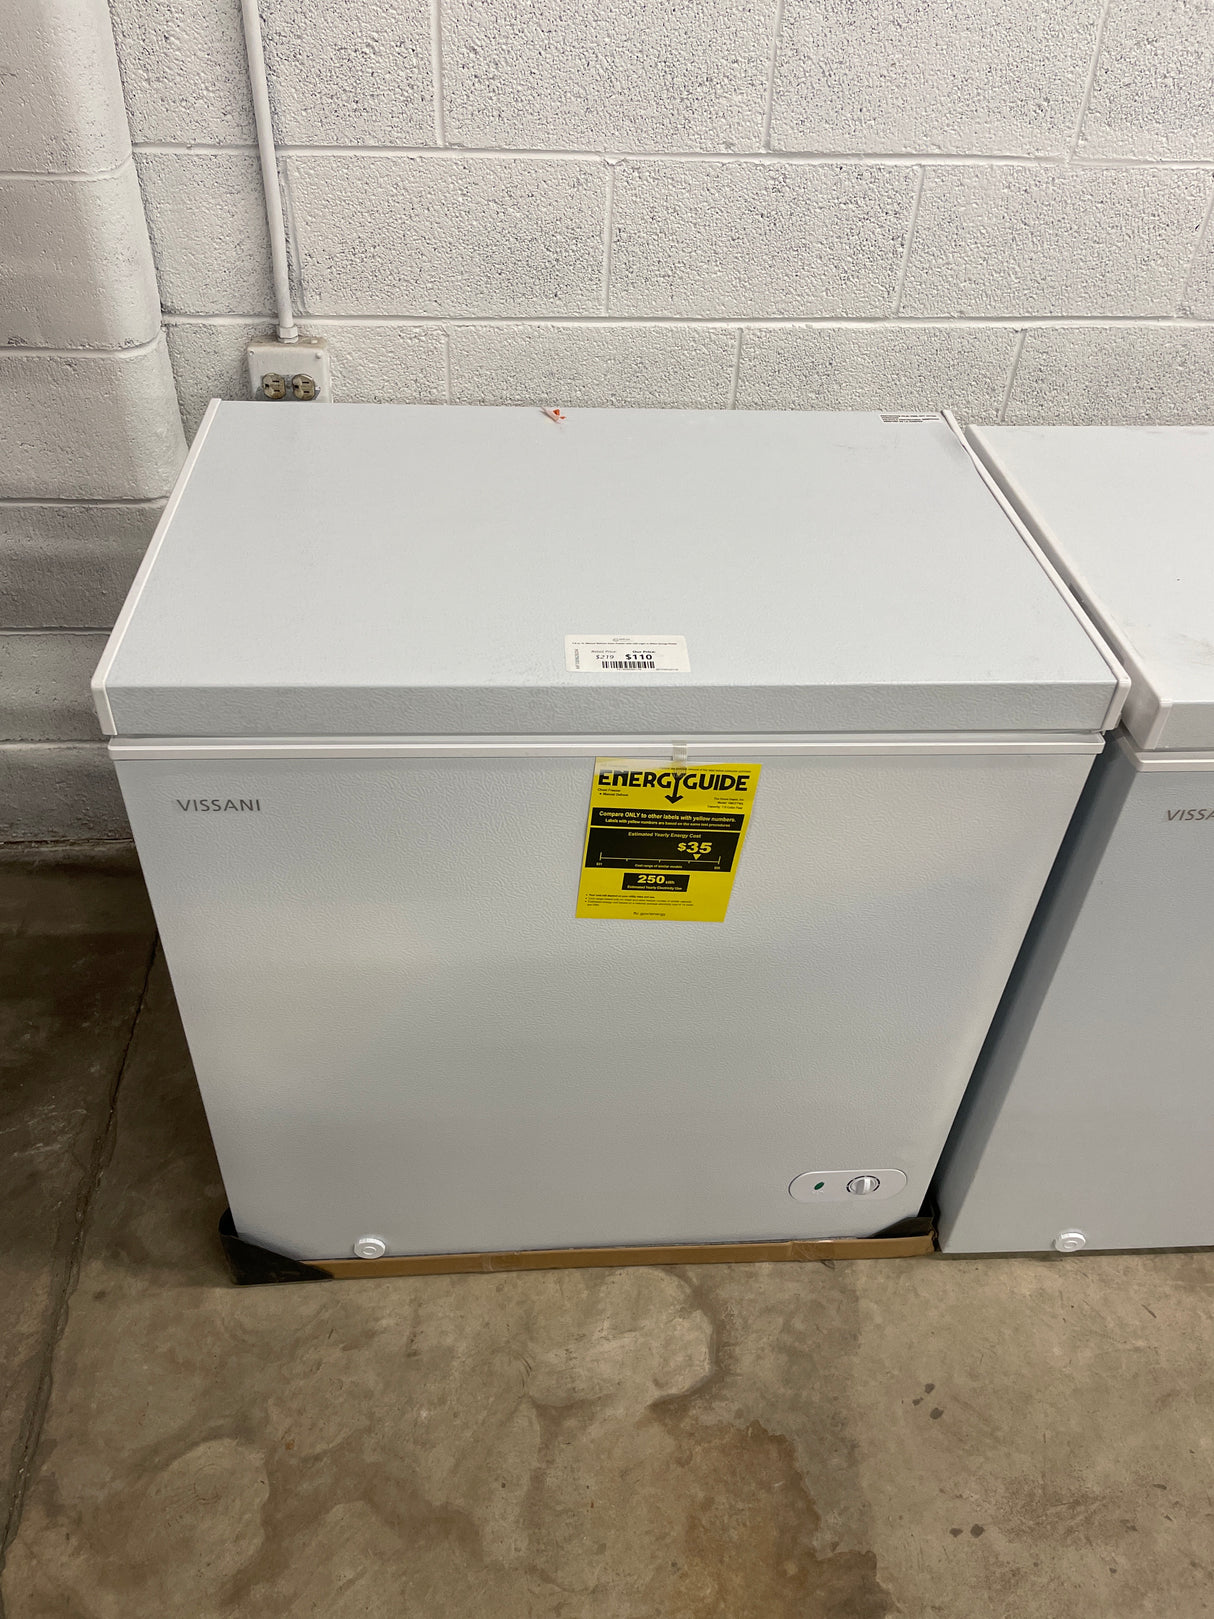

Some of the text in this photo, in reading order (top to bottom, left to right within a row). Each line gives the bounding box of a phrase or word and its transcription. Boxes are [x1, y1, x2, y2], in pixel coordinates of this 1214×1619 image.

[598, 770, 750, 802] ENERGYGUIDE
[176, 799, 260, 812] VISSANI
[677, 842, 712, 854] $35
[637, 874, 665, 884] 250
